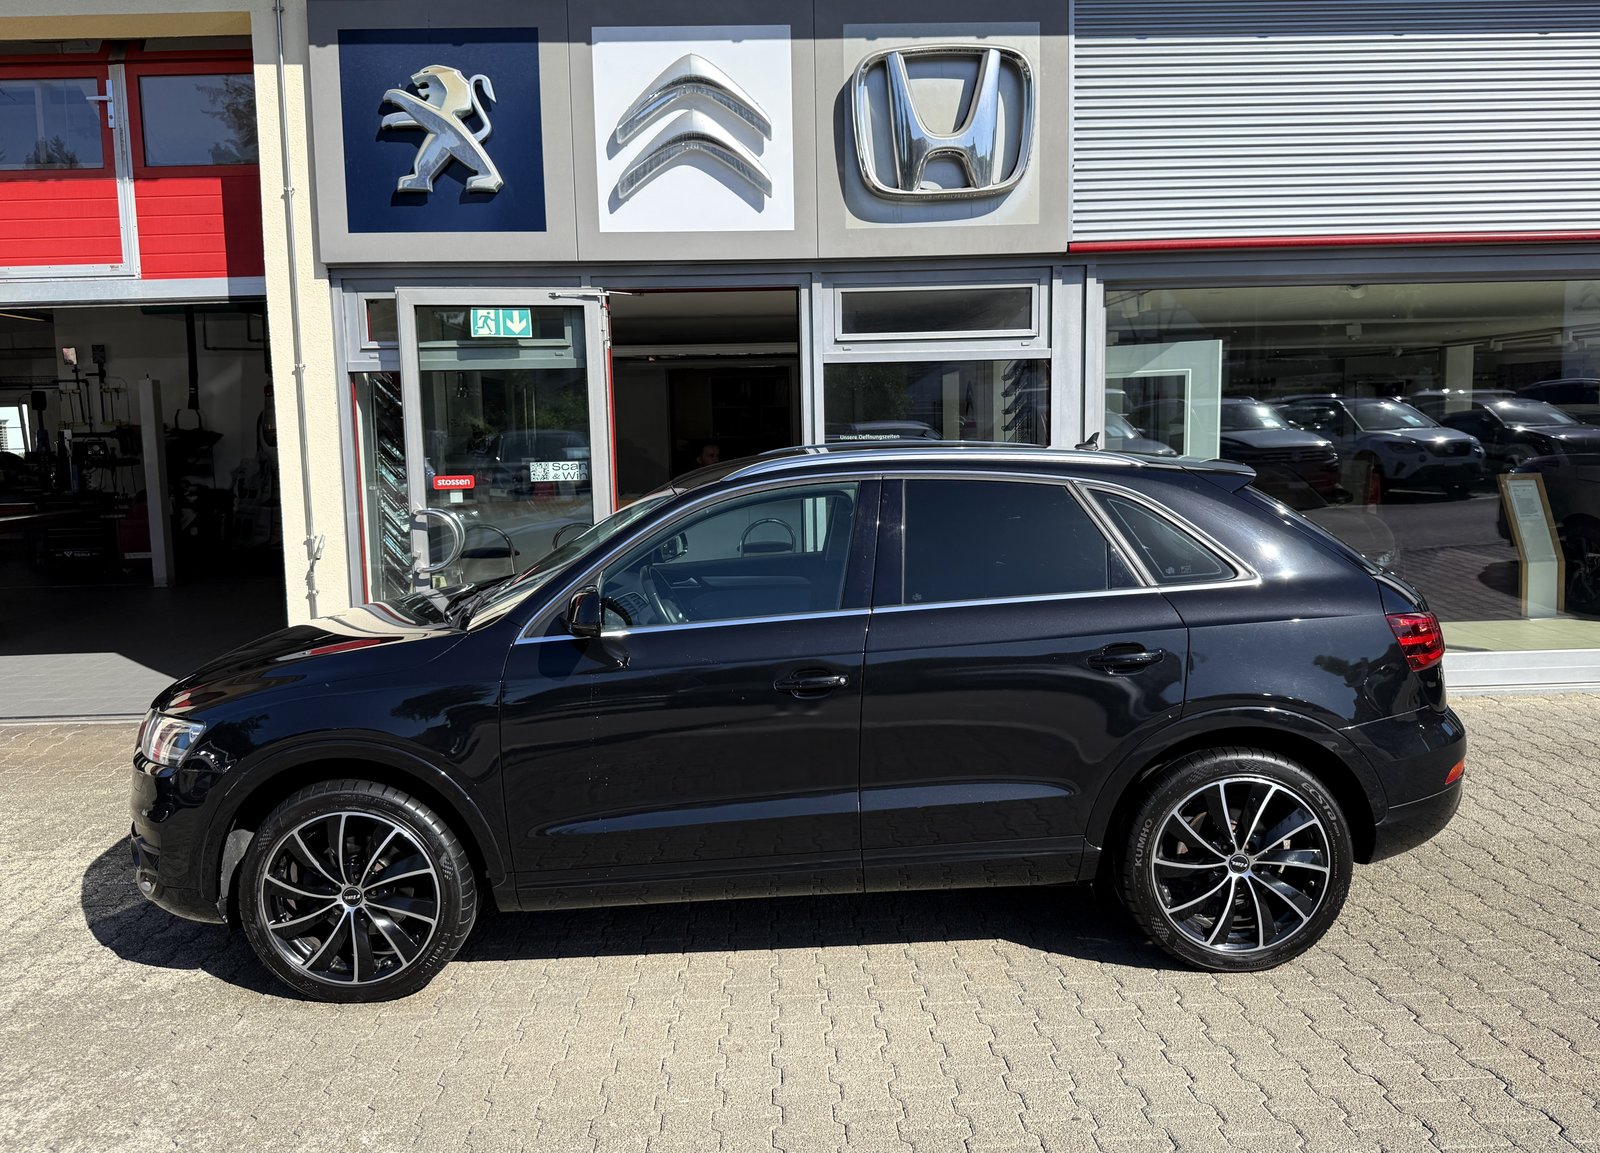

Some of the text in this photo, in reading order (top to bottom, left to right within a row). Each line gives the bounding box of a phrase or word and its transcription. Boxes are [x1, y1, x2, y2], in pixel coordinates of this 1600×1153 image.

[552, 462, 588, 471] Scan
[562, 472, 588, 480] Win
[437, 477, 471, 486] stossen
[1134, 818, 1153, 867] KUMHO
